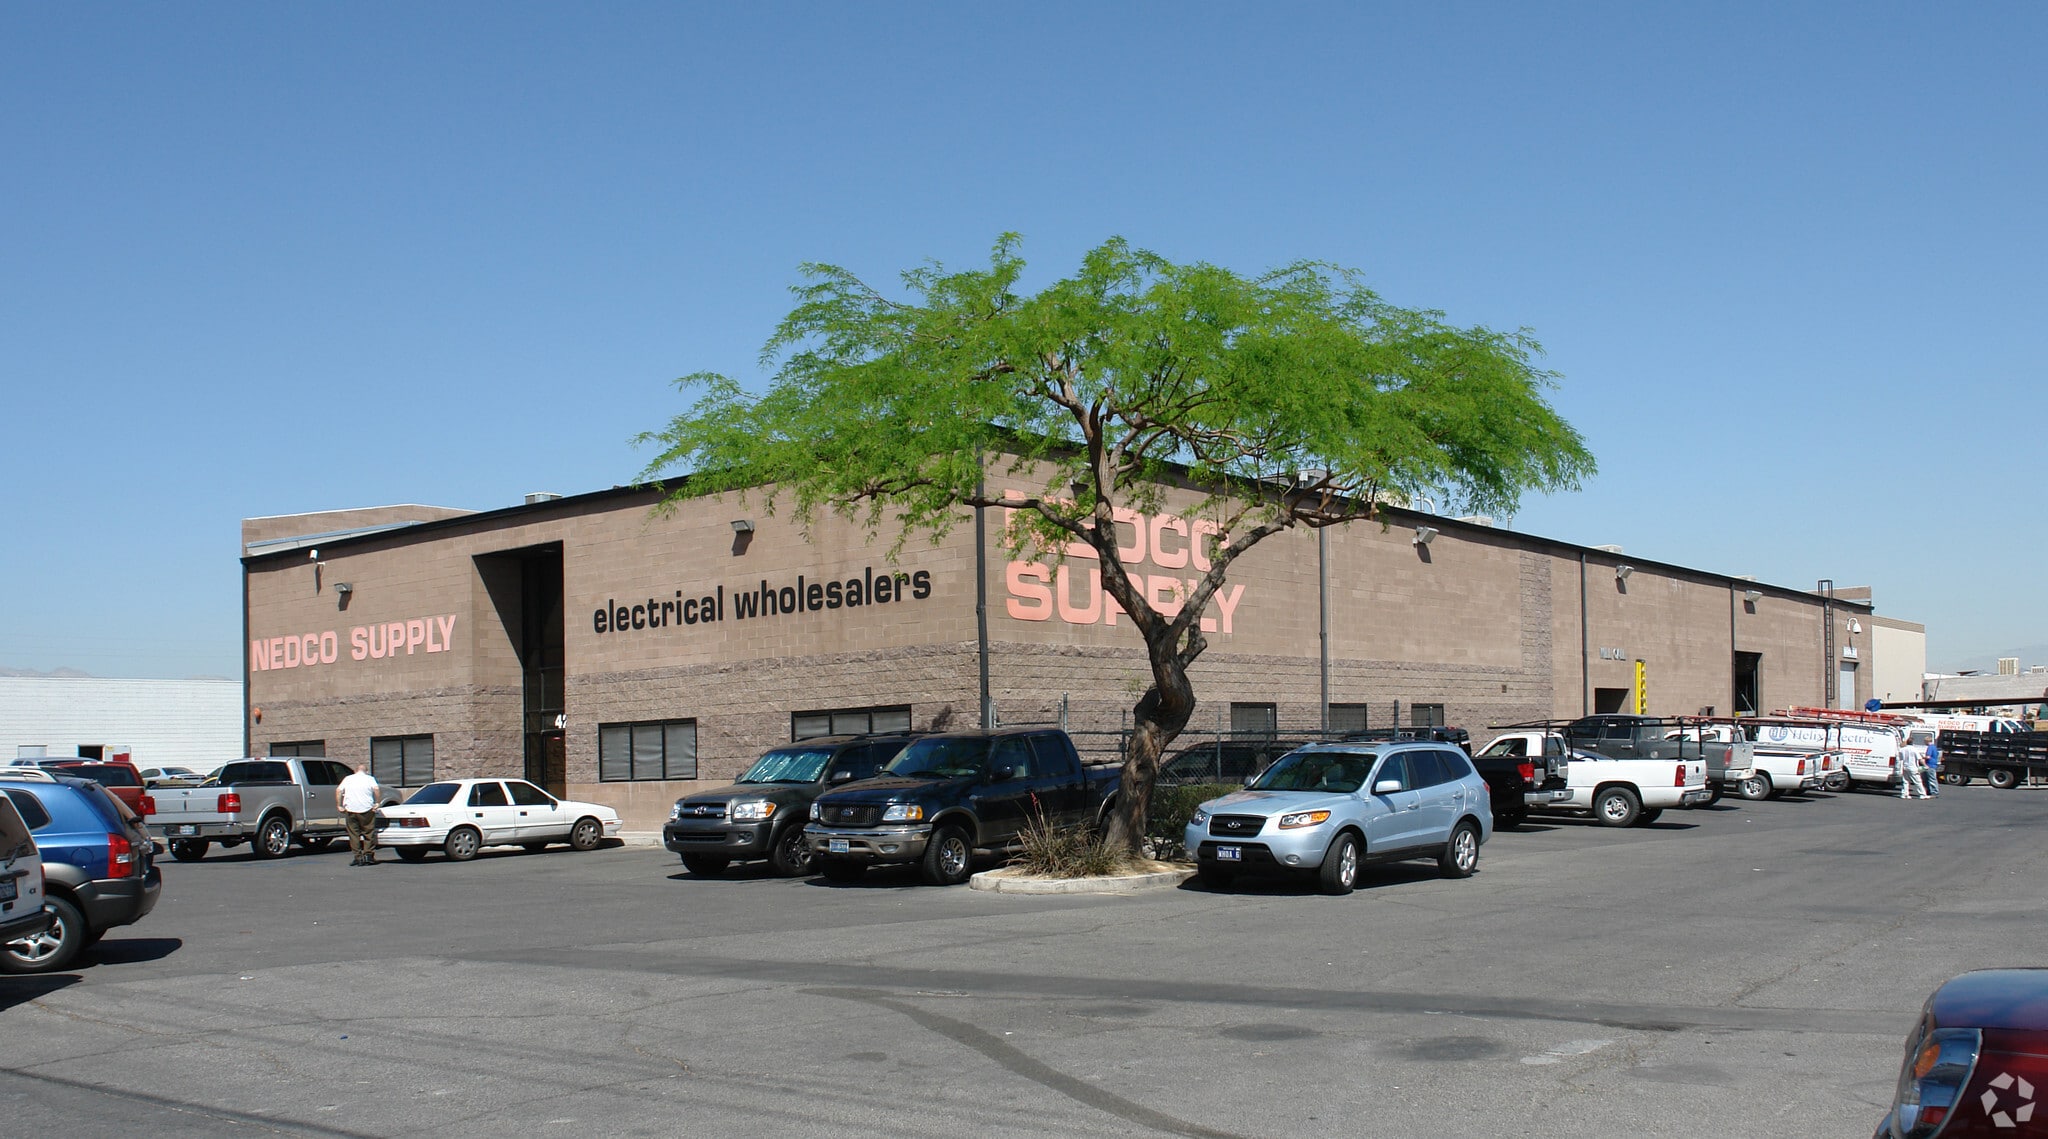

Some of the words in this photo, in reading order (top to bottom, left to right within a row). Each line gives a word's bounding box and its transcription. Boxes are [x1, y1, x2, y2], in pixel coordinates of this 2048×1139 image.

[593, 585, 723, 633] electrical
[734, 566, 931, 619] wholesalers
[252, 630, 338, 671] NEDCO
[351, 615, 457, 661] SUPPLY
[1792, 730, 1824, 740] Helix
[1828, 731, 1874, 743] Electric
